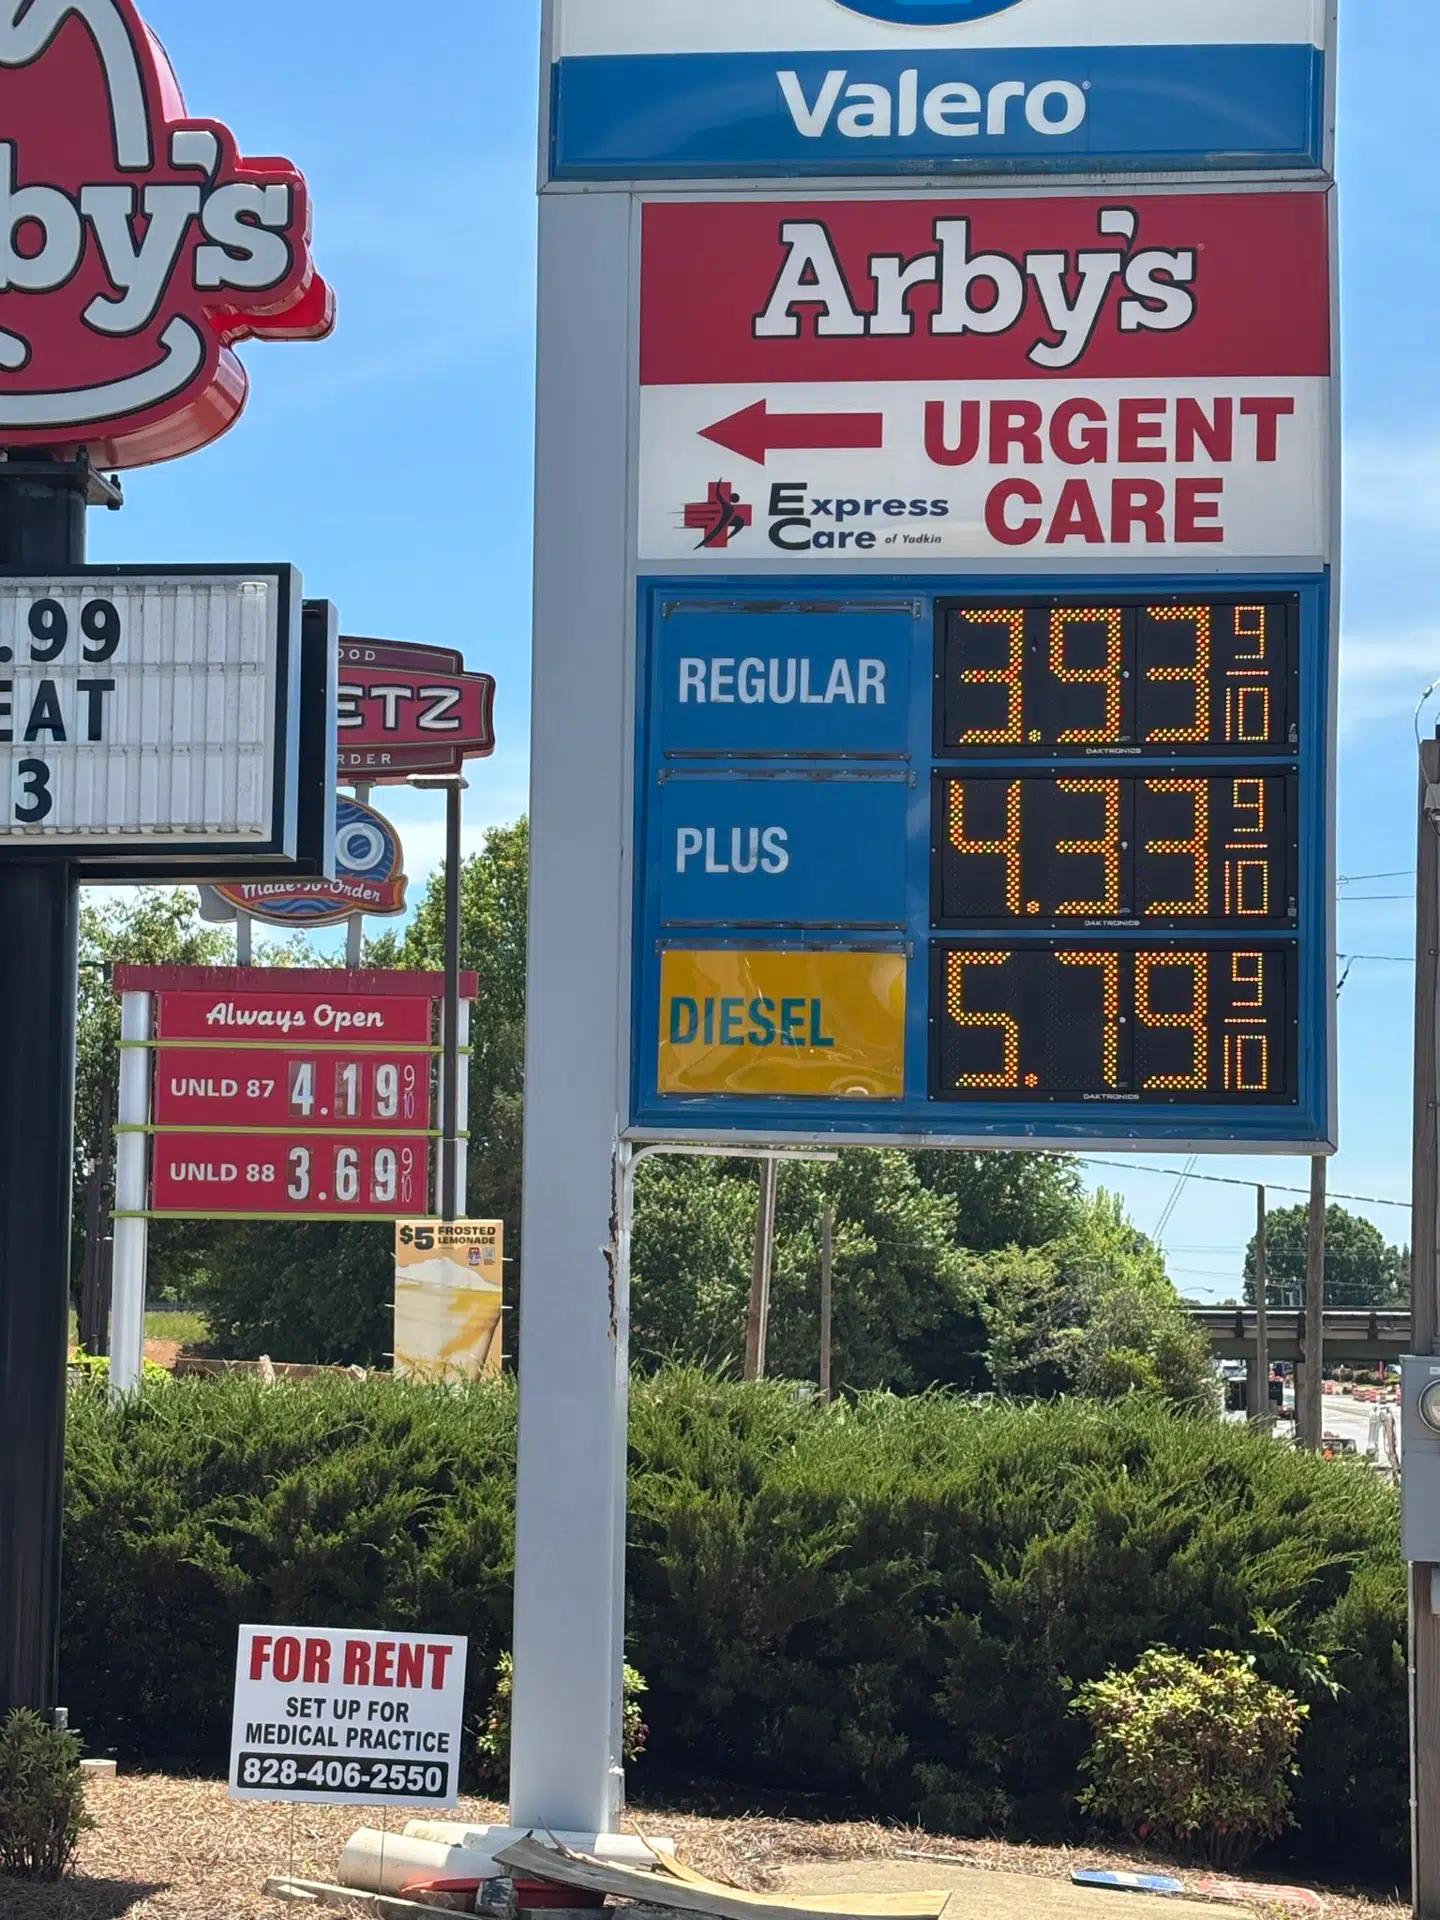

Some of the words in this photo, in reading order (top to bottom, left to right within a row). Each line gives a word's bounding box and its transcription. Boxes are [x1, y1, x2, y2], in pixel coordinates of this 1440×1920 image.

[776, 69, 1087, 138] Valero
[751, 207, 1197, 369] Arby's
[923, 397, 1295, 467] URGENT
[768, 482, 949, 522] Express
[984, 477, 1225, 546] CARE
[768, 517, 876, 551] Care
[884, 533, 898, 545] of
[902, 533, 942, 544] Yadkin
[678, 656, 887, 705] REGULAR
[958, 604, 1211, 744] 3.93
[1085, 747, 1142, 755] DAKTRONICS
[15, 758, 53, 823] 3
[676, 826, 790, 875] PLUS
[949, 776, 1209, 916] 4.33
[206, 1003, 307, 1033] Always
[313, 1003, 385, 1033] Open
[669, 996, 835, 1047] DIESEL
[947, 950, 1209, 1090] 5.79
[171, 1078, 239, 1098] UNLD
[246, 1079, 276, 1099] 87
[291, 1062, 399, 1118] 4.19
[403, 1064, 416, 1092] 9
[1082, 1093, 1140, 1101] DAKTRONICS
[170, 1162, 238, 1182] UNLD
[246, 1163, 276, 1183] 88
[287, 1146, 397, 1202] 3.69
[401, 1147, 413, 1175] 9
[400, 1225, 434, 1250] $5
[438, 1226, 496, 1235] FROSTED
[438, 1236, 495, 1244] LEMONADE
[249, 1636, 331, 1683] FOR
[343, 1640, 453, 1690] RENT
[286, 1696, 326, 1719] SET
[333, 1699, 361, 1721] UP
[368, 1701, 409, 1723] FOR
[245, 1722, 338, 1748] MEDICAL
[346, 1727, 450, 1753] PRACTICE
[243, 1757, 443, 1792] 828-406-2550
